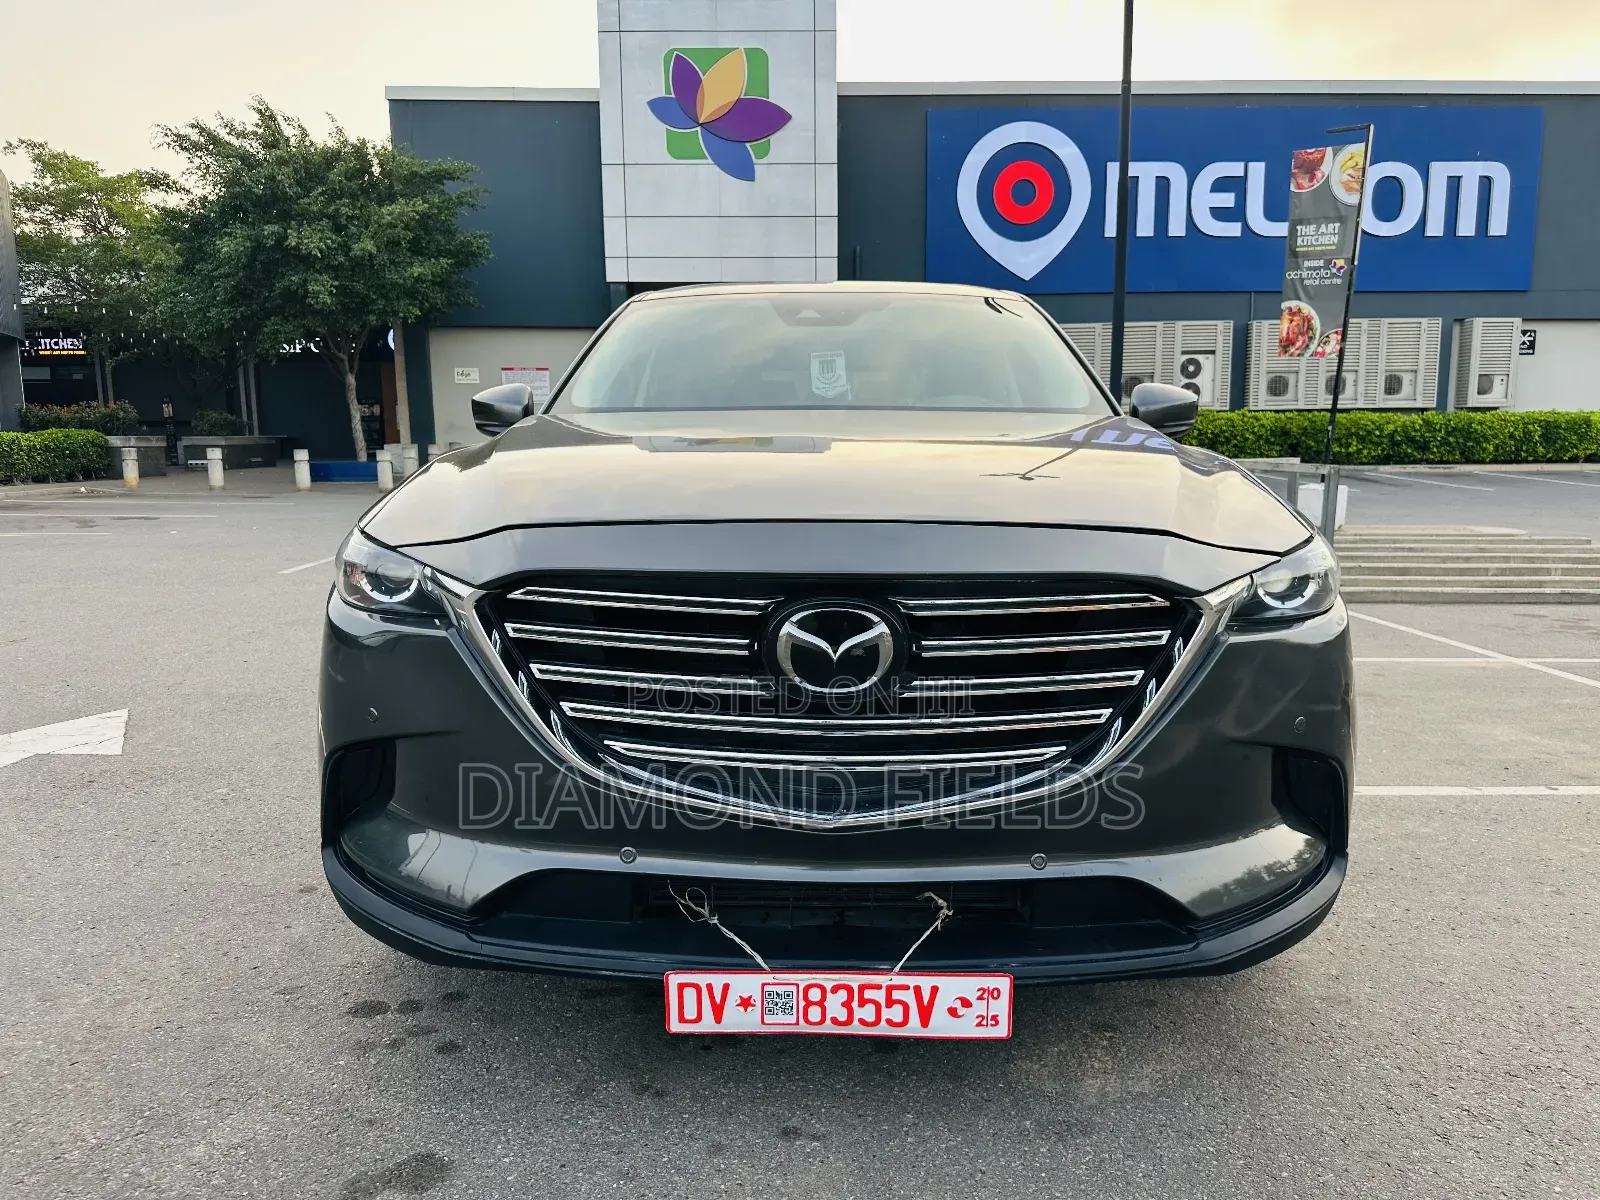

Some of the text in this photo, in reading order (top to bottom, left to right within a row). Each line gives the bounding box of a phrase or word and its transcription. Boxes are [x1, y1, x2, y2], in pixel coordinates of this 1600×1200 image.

[1104, 161, 1511, 237] MELOM
[1296, 223, 1340, 235] THE ART
[1297, 235, 1338, 245] KITCHEN
[1303, 259, 1325, 267] INSIDE
[1285, 268, 1331, 279] achimota
[1303, 277, 1342, 286] retail centre
[676, 982, 940, 1029] DV 8355V
